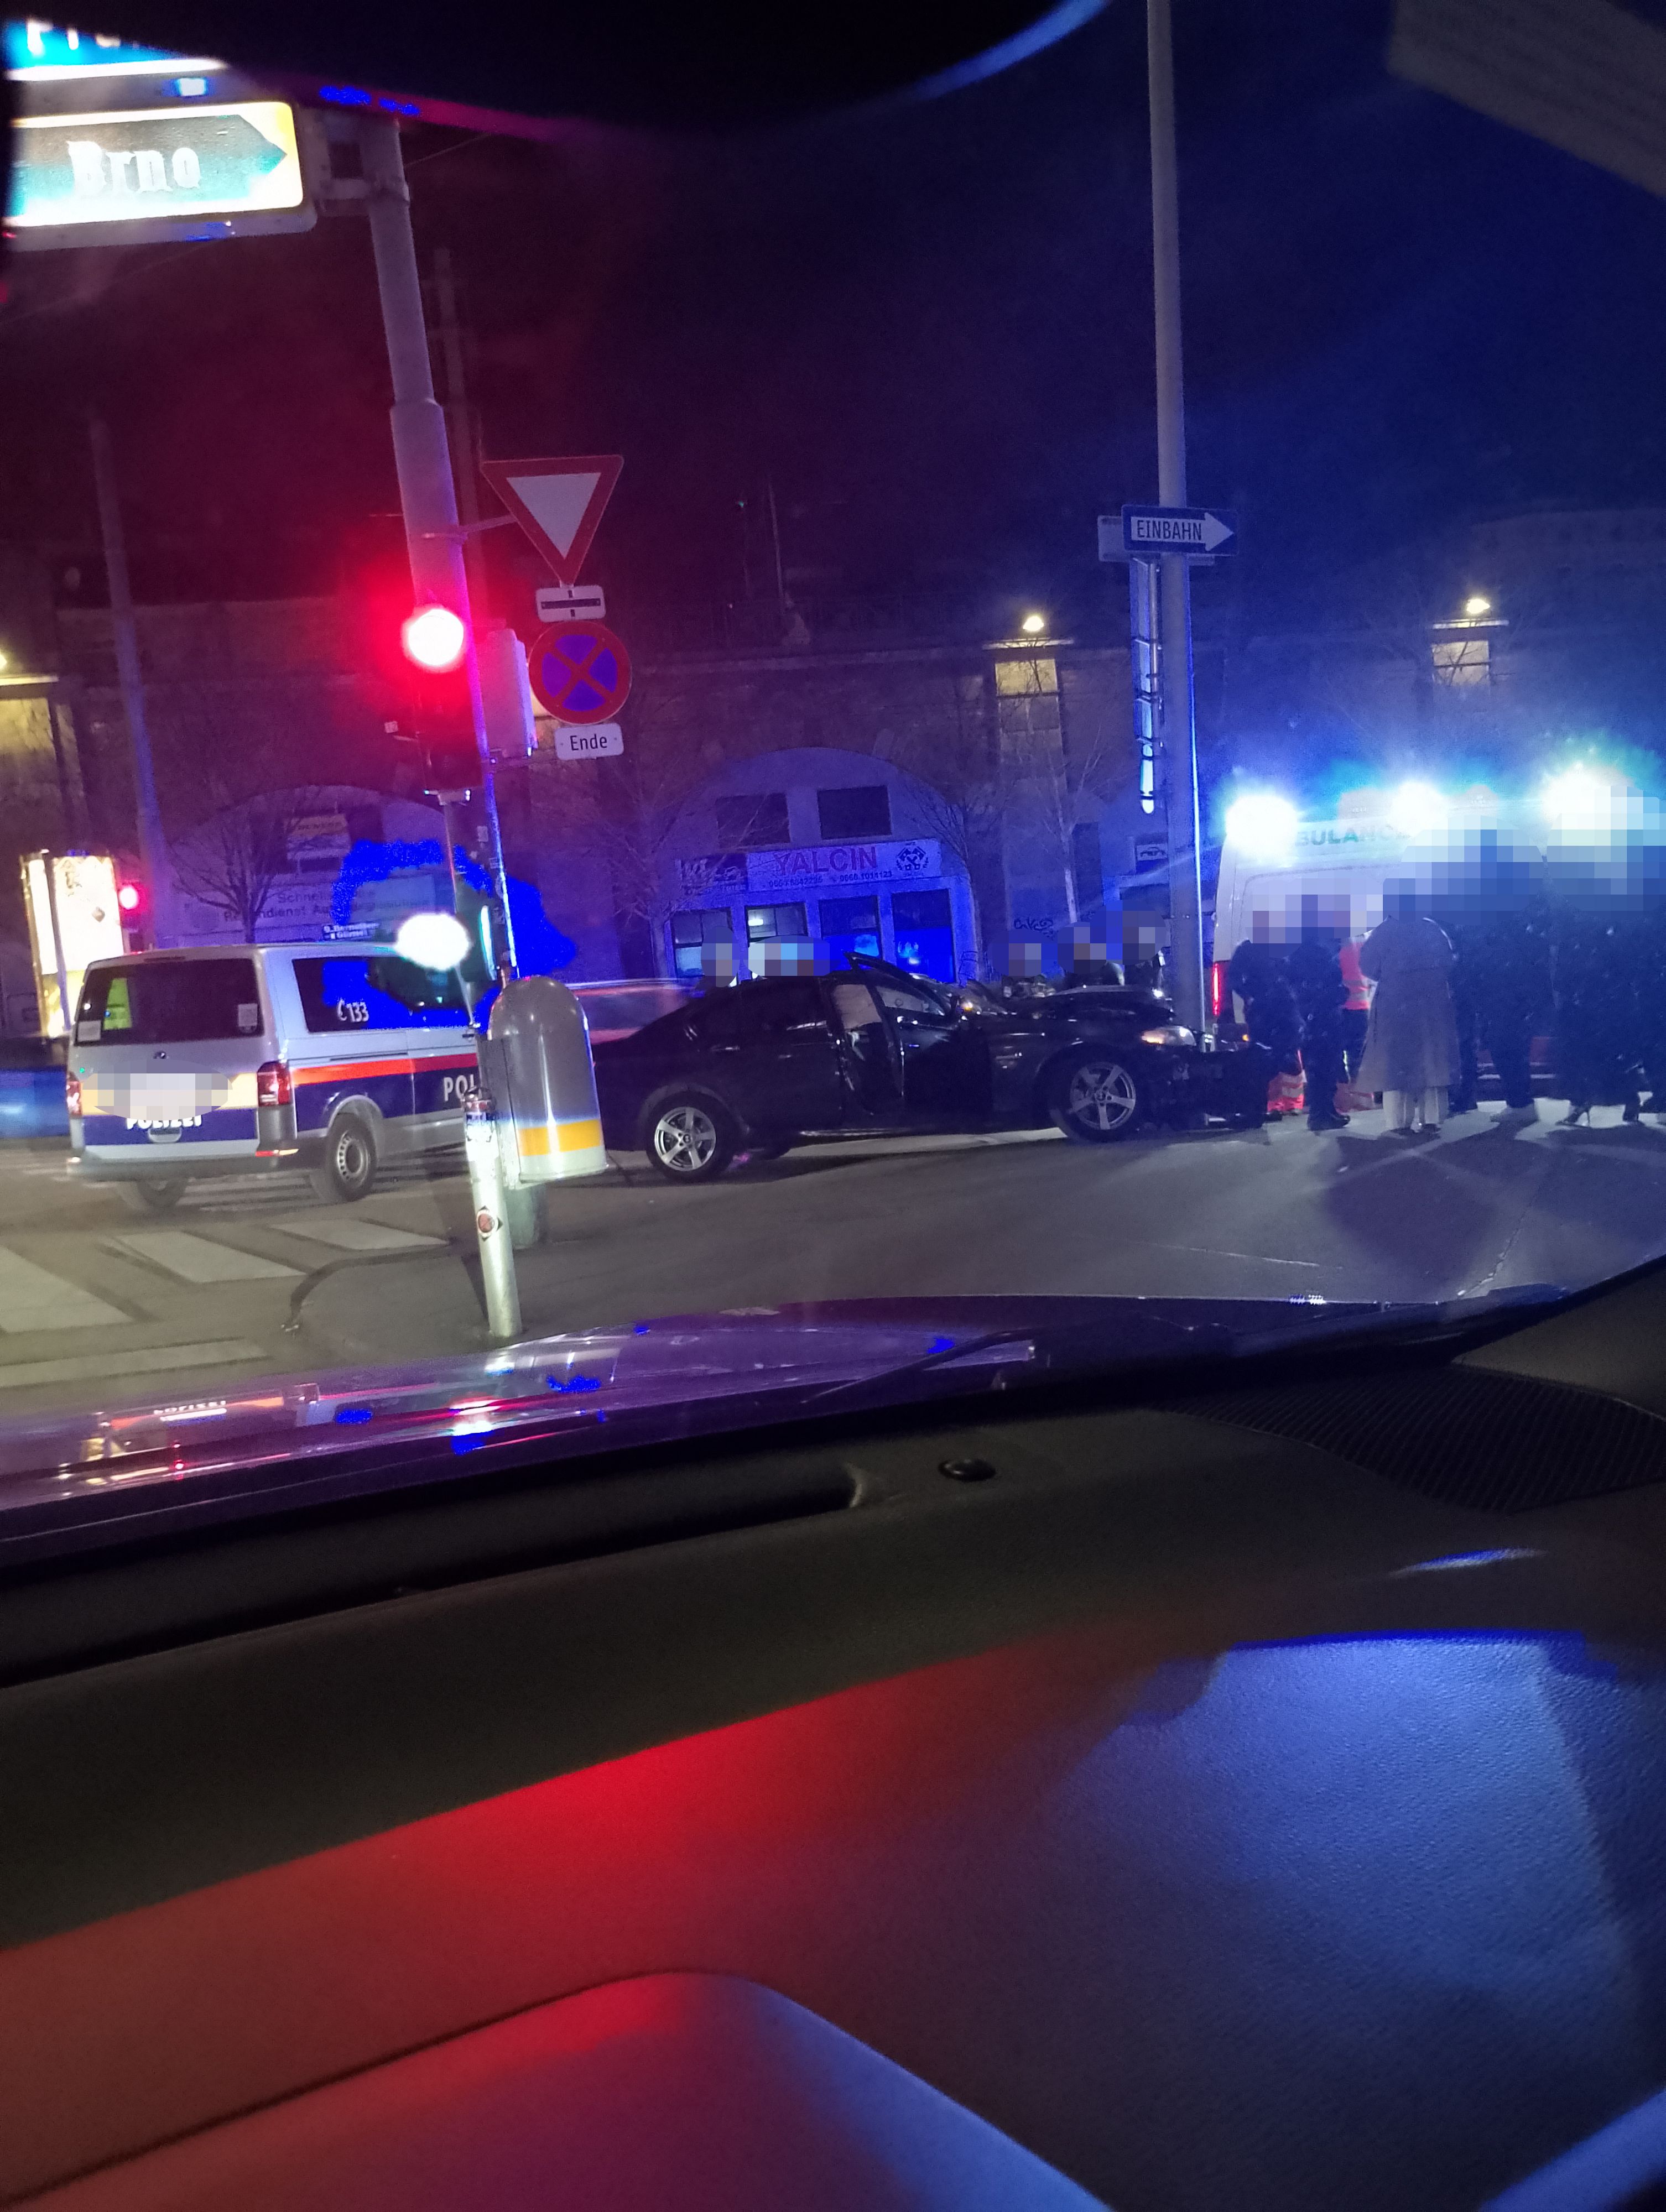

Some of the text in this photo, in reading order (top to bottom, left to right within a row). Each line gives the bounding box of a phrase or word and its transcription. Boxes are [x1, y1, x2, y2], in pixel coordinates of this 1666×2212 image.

[67, 140, 202, 194] Brno
[1137, 520, 1201, 540] EINBAHN
[570, 733, 608, 750] Ende
[774, 847, 877, 875] YALCIN
[346, 1001, 369, 1022] 133
